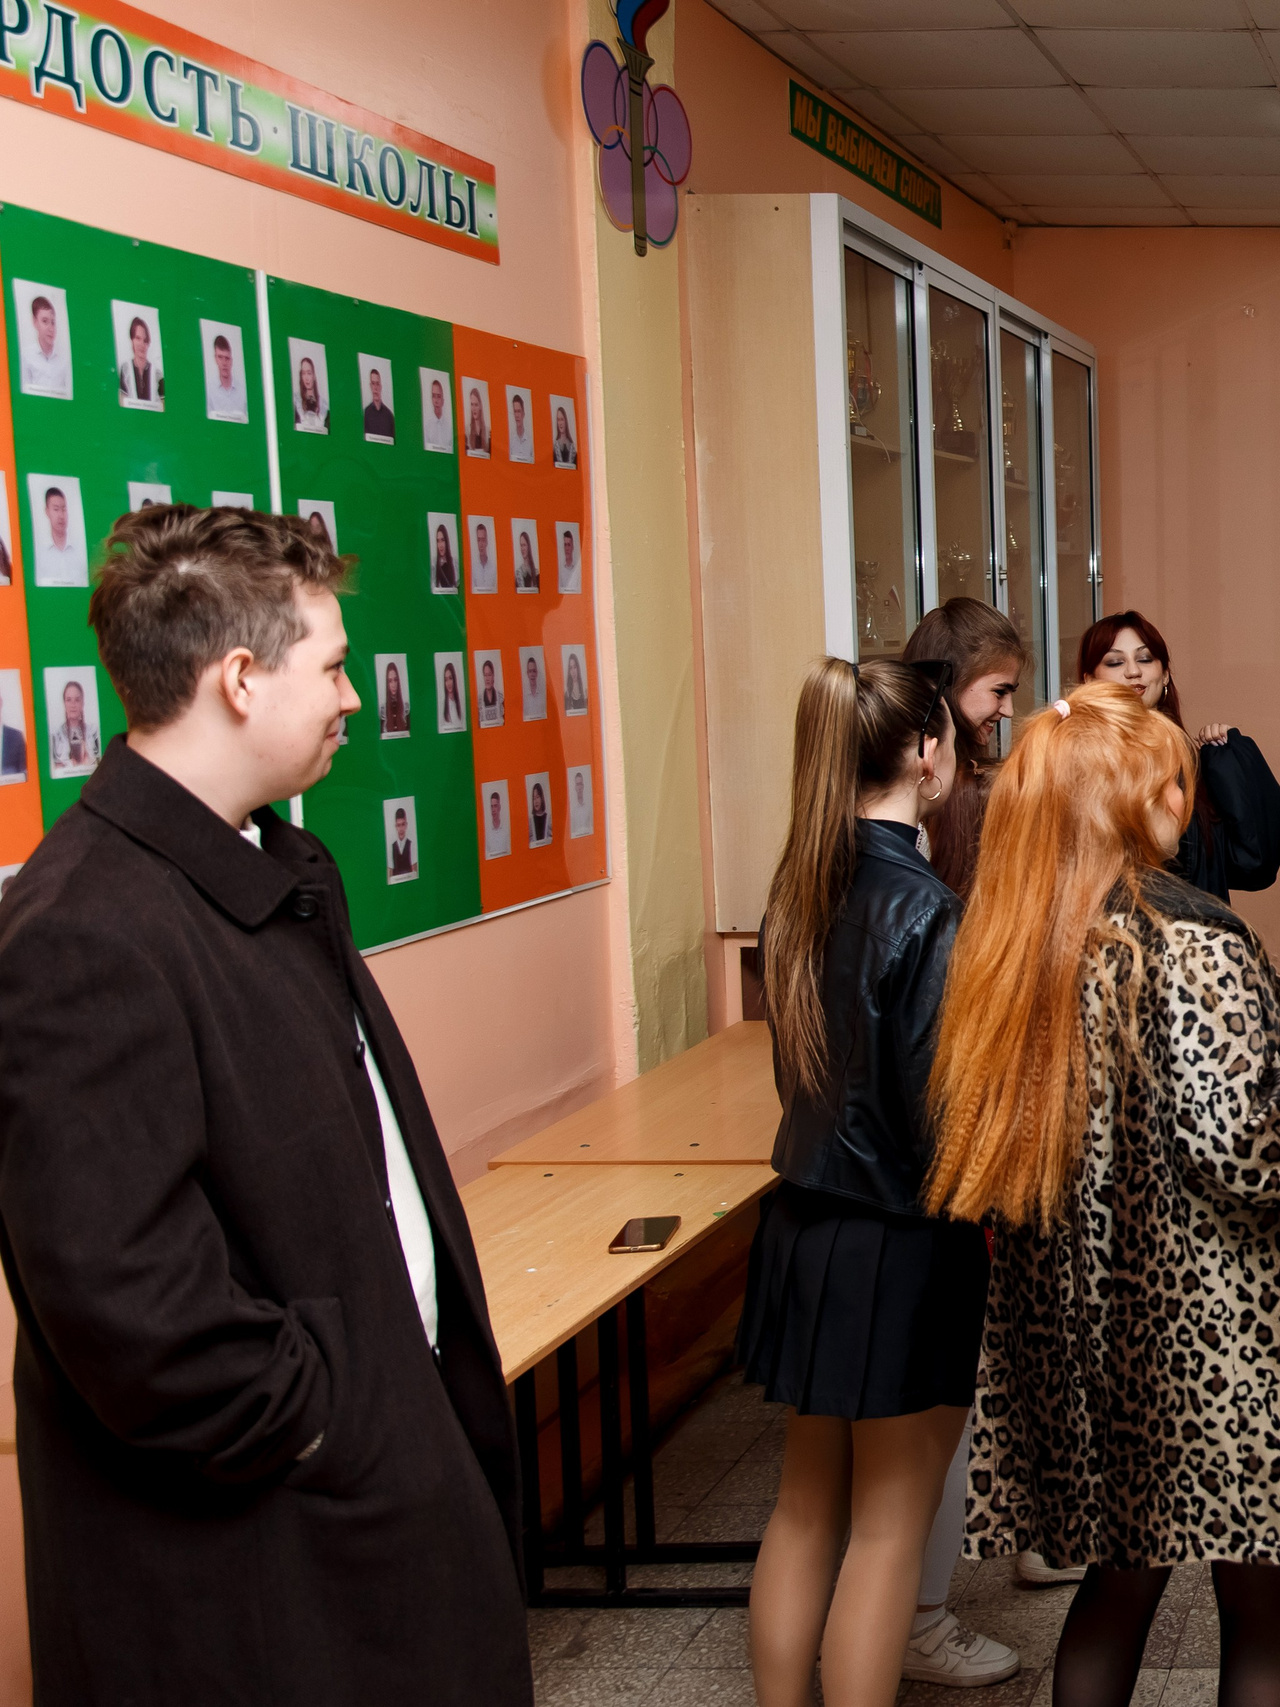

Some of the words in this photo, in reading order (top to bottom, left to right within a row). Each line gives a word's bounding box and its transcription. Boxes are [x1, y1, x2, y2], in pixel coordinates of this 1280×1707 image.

[286, 104, 480, 237] ШКОЛЫ
[793, 91, 822, 142] МЫ
[825, 113, 898, 192] ВЫБИРАЕМ
[900, 166, 940, 220] СПОРТ!
